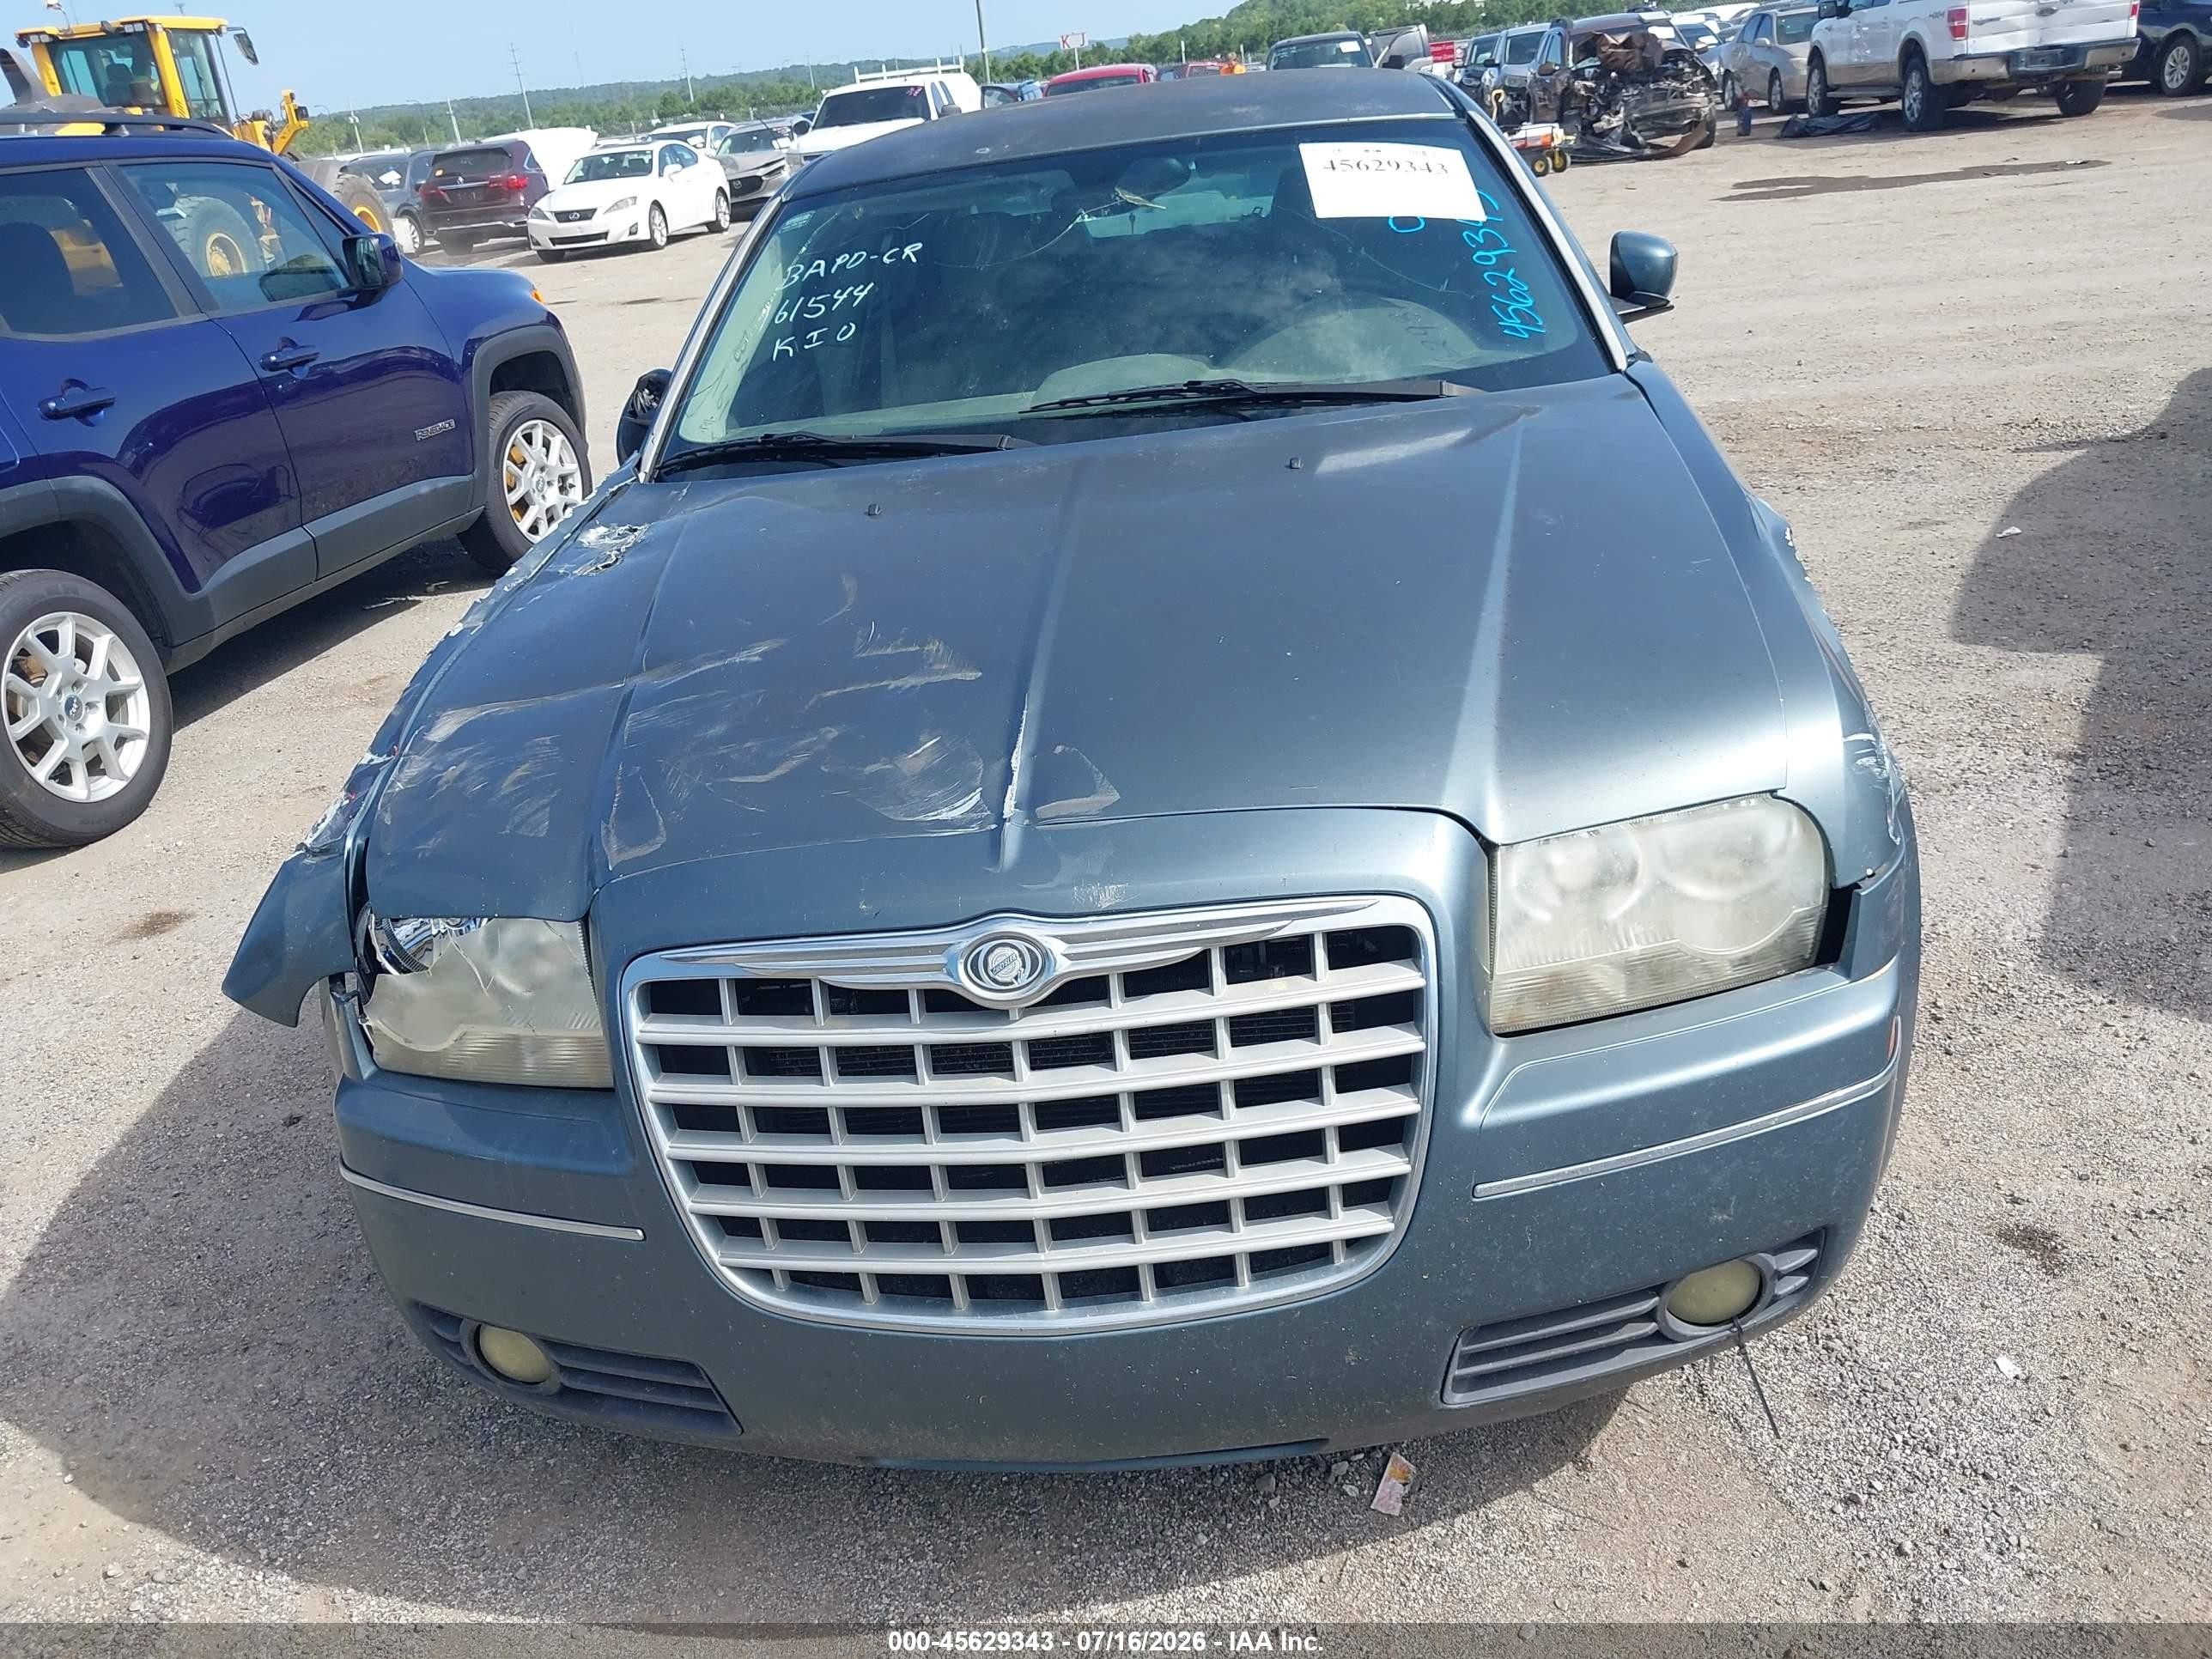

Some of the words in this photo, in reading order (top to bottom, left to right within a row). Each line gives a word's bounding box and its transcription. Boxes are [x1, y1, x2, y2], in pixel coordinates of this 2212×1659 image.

[1061, 34, 1071, 48] K
[1323, 159, 1449, 174] 45629343
[775, 242, 923, 291] BAPD-CR
[775, 282, 875, 325] 61544
[414, 419, 455, 441] RENEGADE
